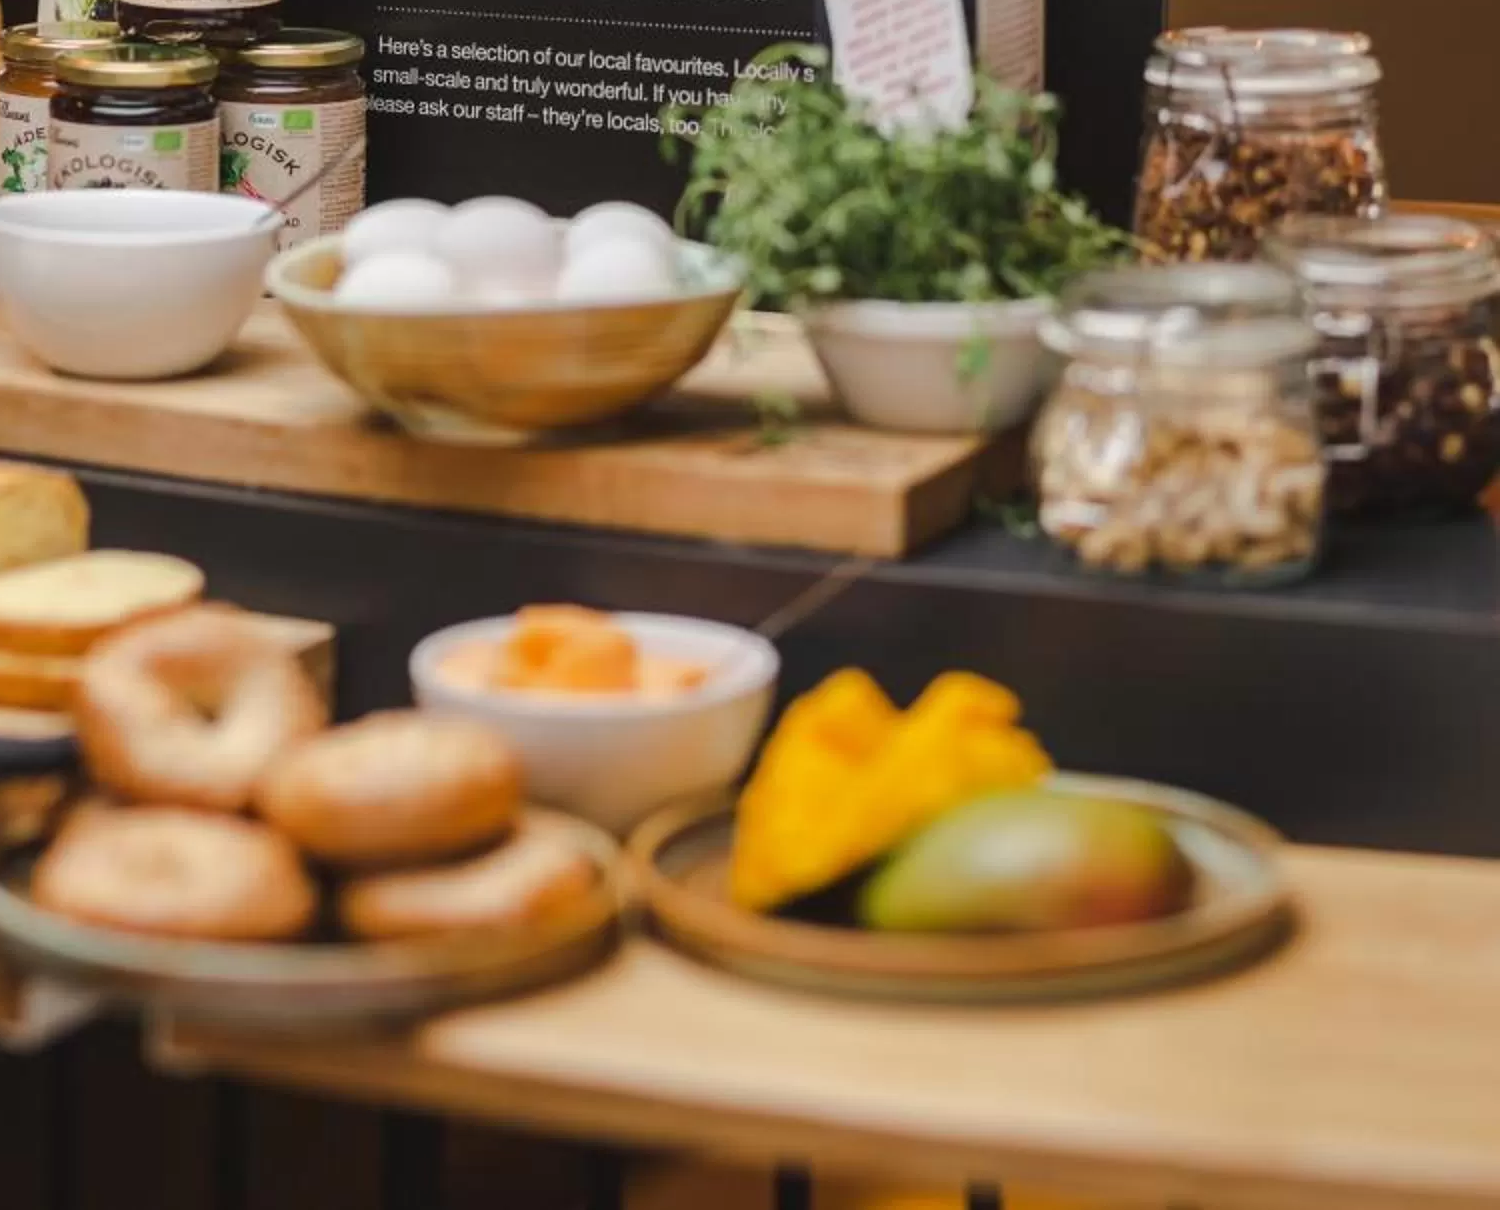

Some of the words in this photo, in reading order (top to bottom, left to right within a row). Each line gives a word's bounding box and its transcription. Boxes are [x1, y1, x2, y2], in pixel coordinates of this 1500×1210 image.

[378, 35, 433, 58] Here's
[436, 43, 448, 59] a
[451, 41, 530, 66] selection
[533, 46, 552, 65] of
[554, 51, 586, 68] our
[589, 49, 631, 71] local
[635, 52, 729, 78] favourites.
[733, 57, 801, 84] Locally
[372, 67, 471, 89] small-scale
[473, 72, 509, 93] and
[512, 74, 551, 101] truly
[553, 78, 649, 104] wonderful.
[653, 83, 665, 103] If
[667, 88, 703, 109] you
[706, 87, 739, 107] hav
[368, 93, 415, 115] lease
[418, 99, 450, 118] ask
[453, 104, 484, 120] our
[485, 103, 525, 123] staff
[542, 106, 604, 132] they're
[607, 110, 664, 136] locals,
[222, 130, 301, 177] LOGISK
